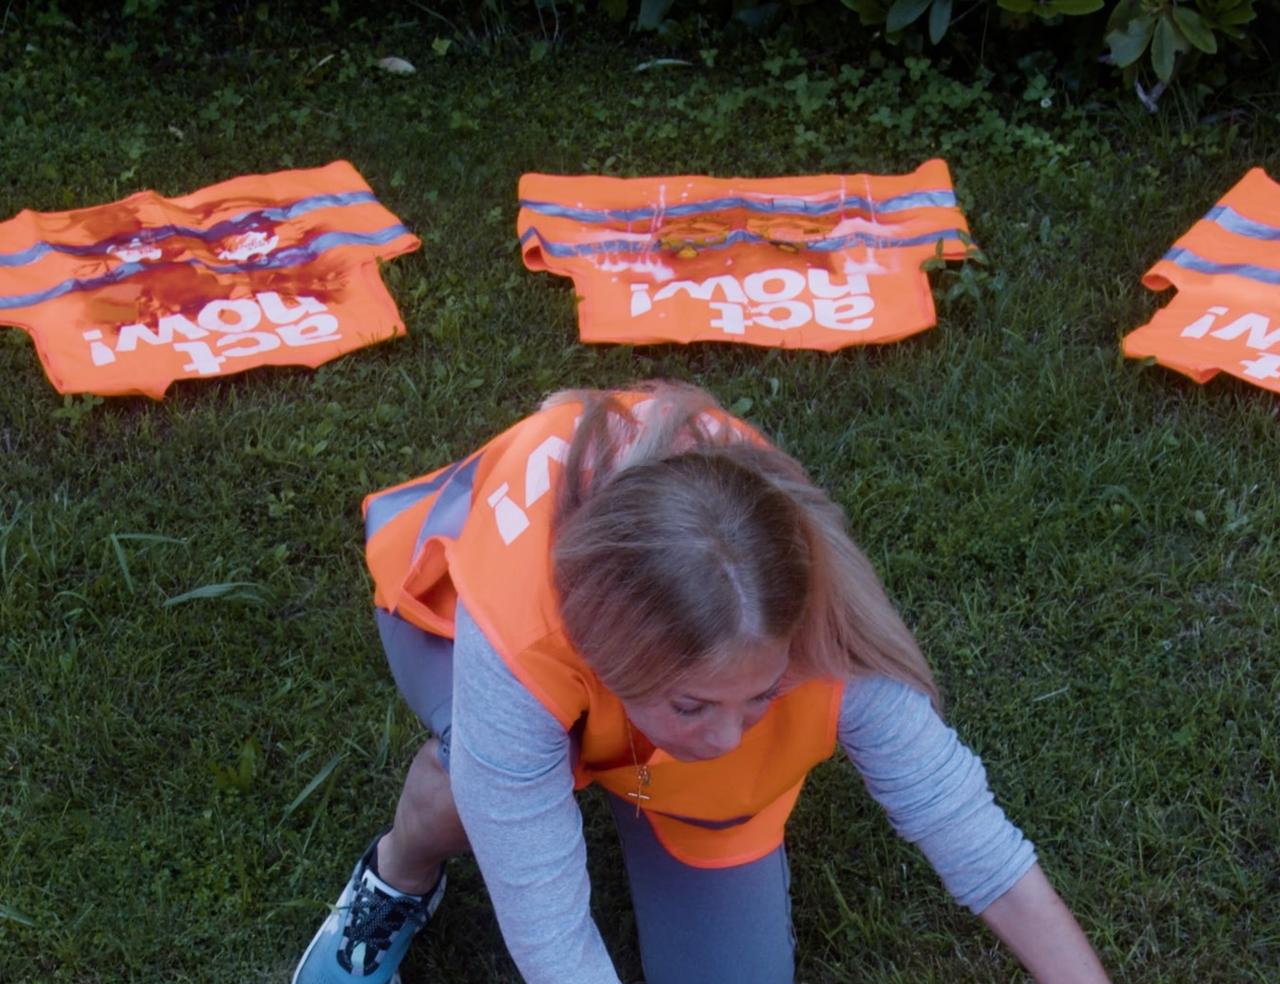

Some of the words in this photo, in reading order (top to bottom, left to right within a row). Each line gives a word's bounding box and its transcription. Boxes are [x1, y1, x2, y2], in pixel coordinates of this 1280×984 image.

[630, 267, 871, 317] now!
[709, 295, 874, 334] act
[82, 291, 327, 367] now!
[173, 312, 342, 375] act
